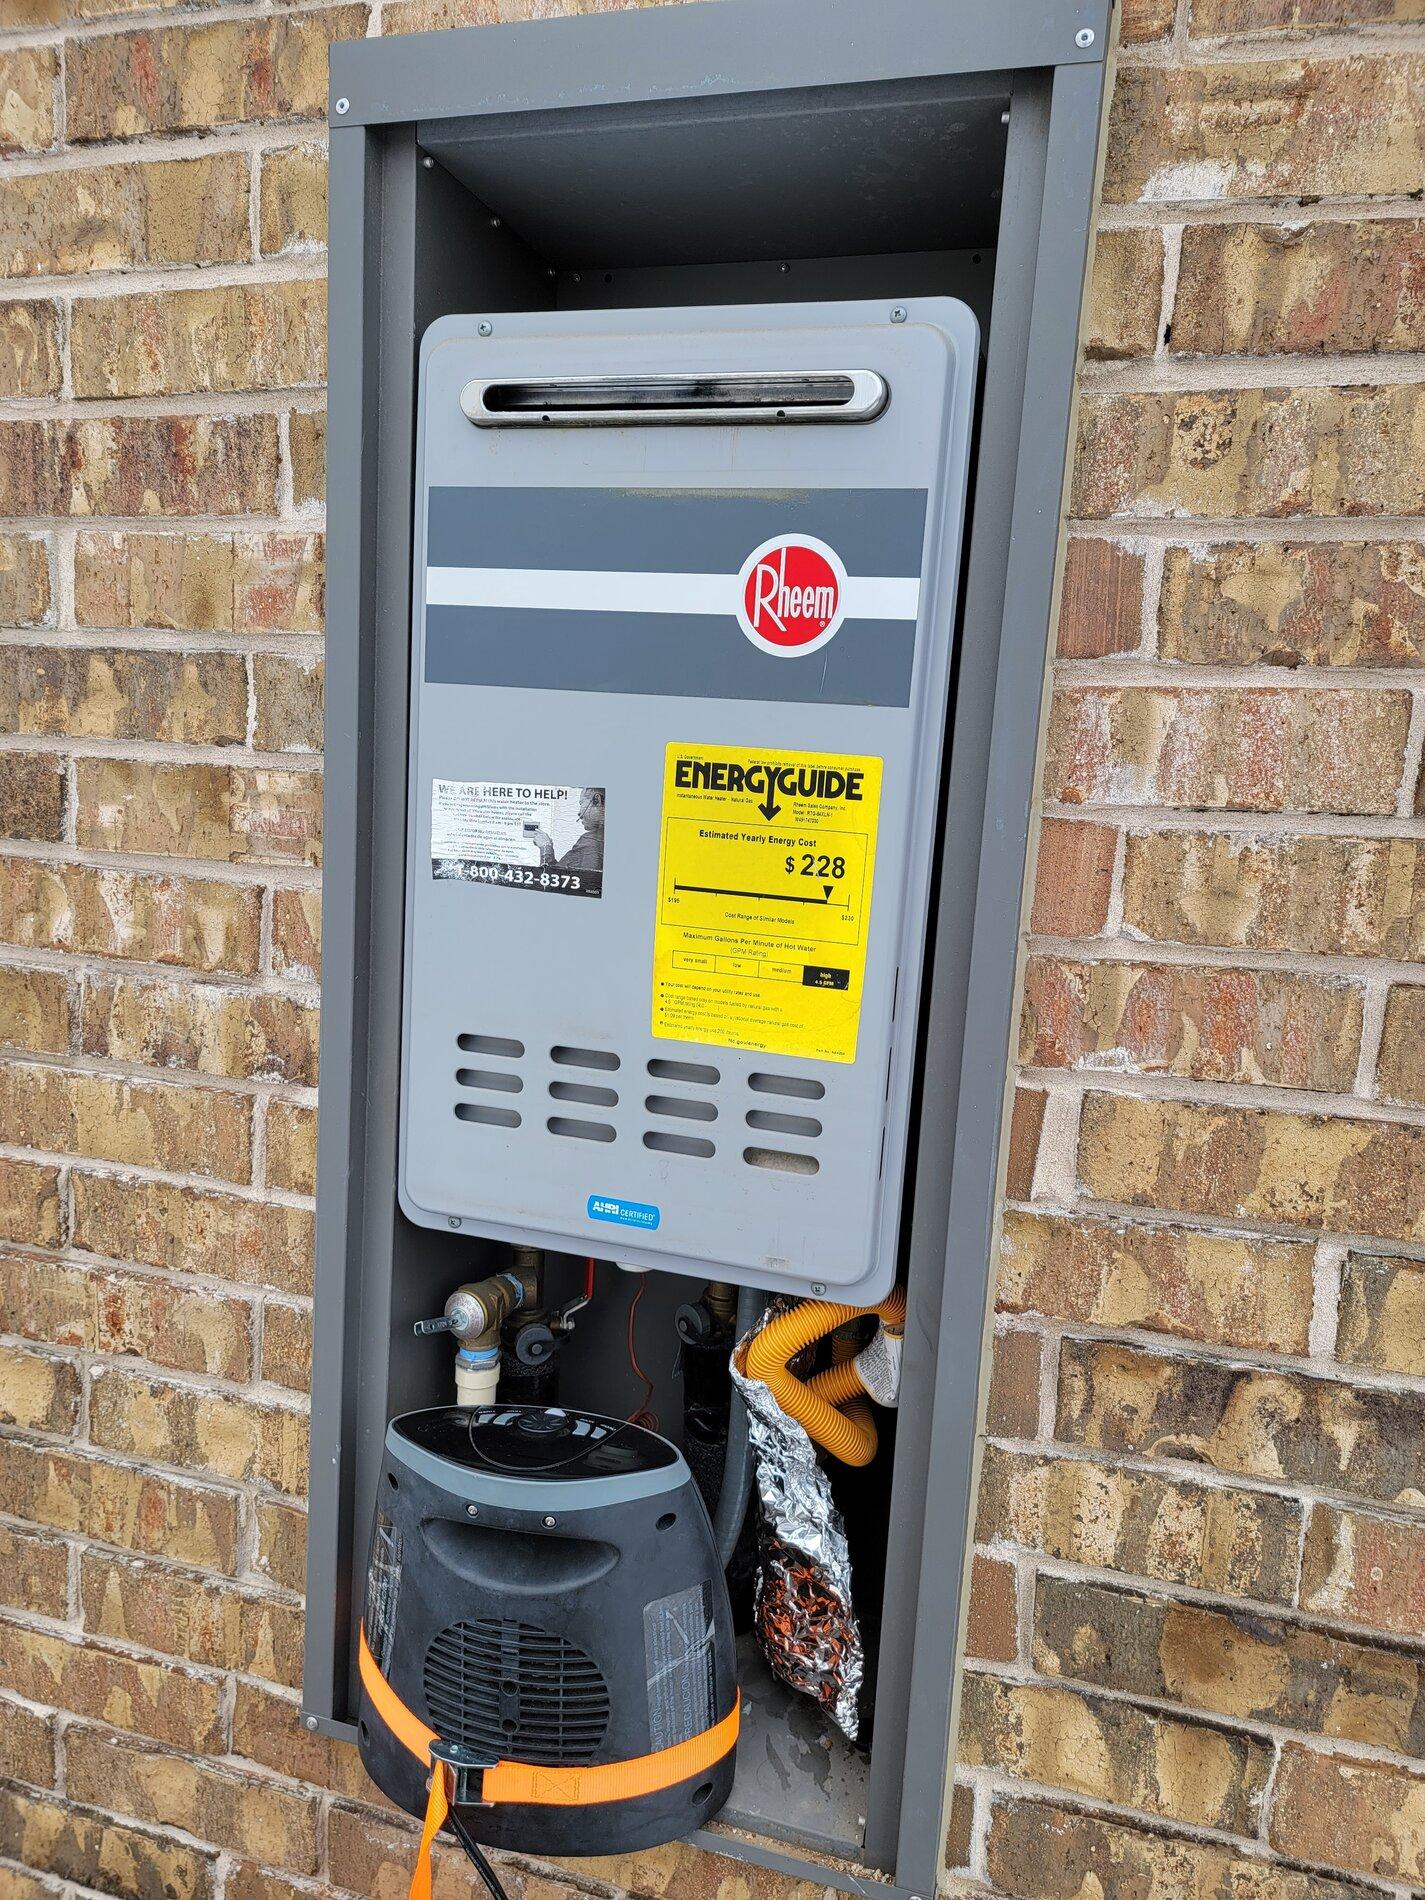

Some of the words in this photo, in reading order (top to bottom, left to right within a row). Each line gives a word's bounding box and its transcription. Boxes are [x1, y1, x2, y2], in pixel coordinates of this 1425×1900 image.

[754, 547, 834, 631] Rheem
[674, 760, 864, 801] ENERGYGUIDE
[483, 786, 513, 797] HERE
[516, 788, 531, 798] TO
[534, 788, 568, 800] HELP!
[700, 830, 738, 840] Estimated
[741, 833, 766, 845] Yearly
[768, 835, 796, 847] Energy
[799, 838, 817, 847] Cost
[785, 856, 795, 875] $
[800, 853, 846, 879] 228
[724, 911, 736, 919] Cost
[737, 913, 752, 921] Range
[759, 915, 776, 923] Similar
[777, 917, 795, 925] Models
[683, 931, 713, 942] Maximum
[714, 935, 739, 944] Gallons
[753, 939, 775, 948] Minute
[776, 941, 783, 949] of
[784, 942, 796, 950] Hot
[797, 944, 816, 953] Water
[730, 947, 747, 956] (GPM
[748, 949, 769, 958] Rating)
[620, 1209, 654, 1221] CERTIFIED
[652, 1708, 664, 1752] CAUTION
